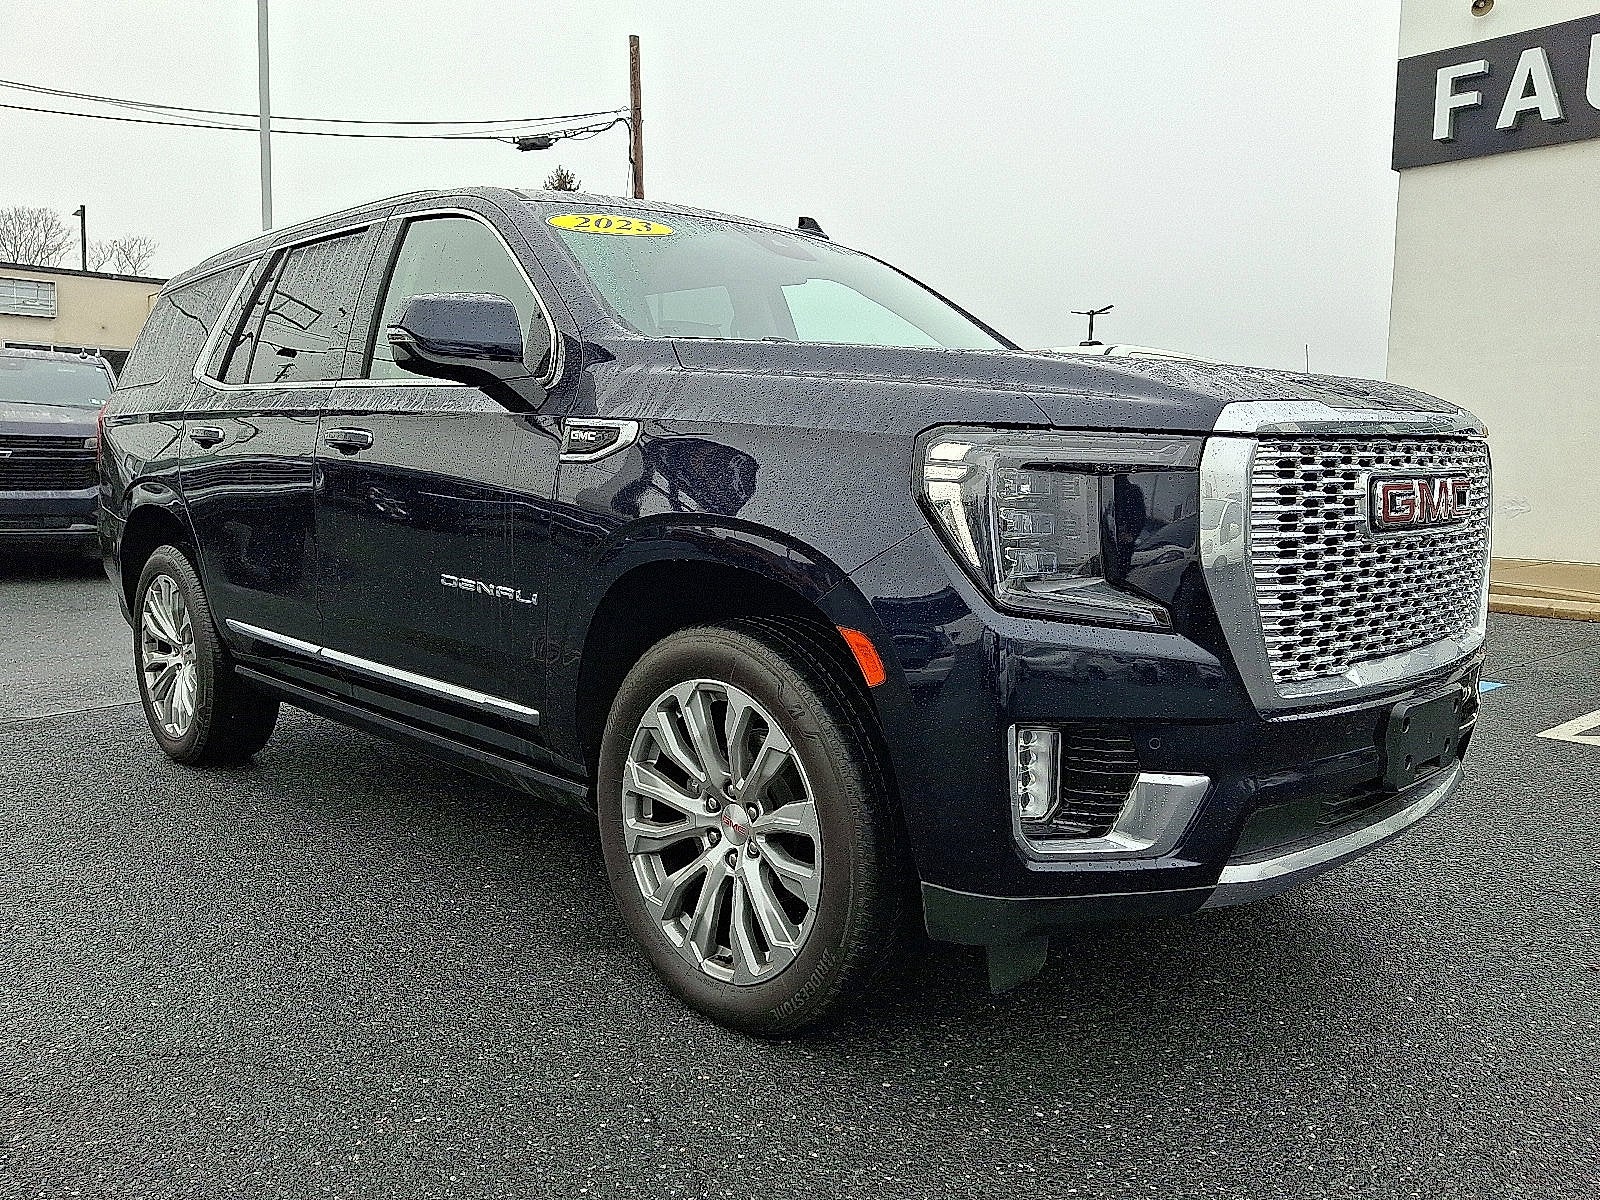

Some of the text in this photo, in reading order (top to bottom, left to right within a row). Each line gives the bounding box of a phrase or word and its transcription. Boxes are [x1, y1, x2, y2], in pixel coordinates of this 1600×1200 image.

[1433, 33, 1600, 140] FA
[574, 217, 652, 232] 2023
[571, 430, 597, 441] GMC
[1380, 480, 1471, 524] GMC
[441, 573, 538, 605] DENALI
[722, 814, 747, 836] GMC
